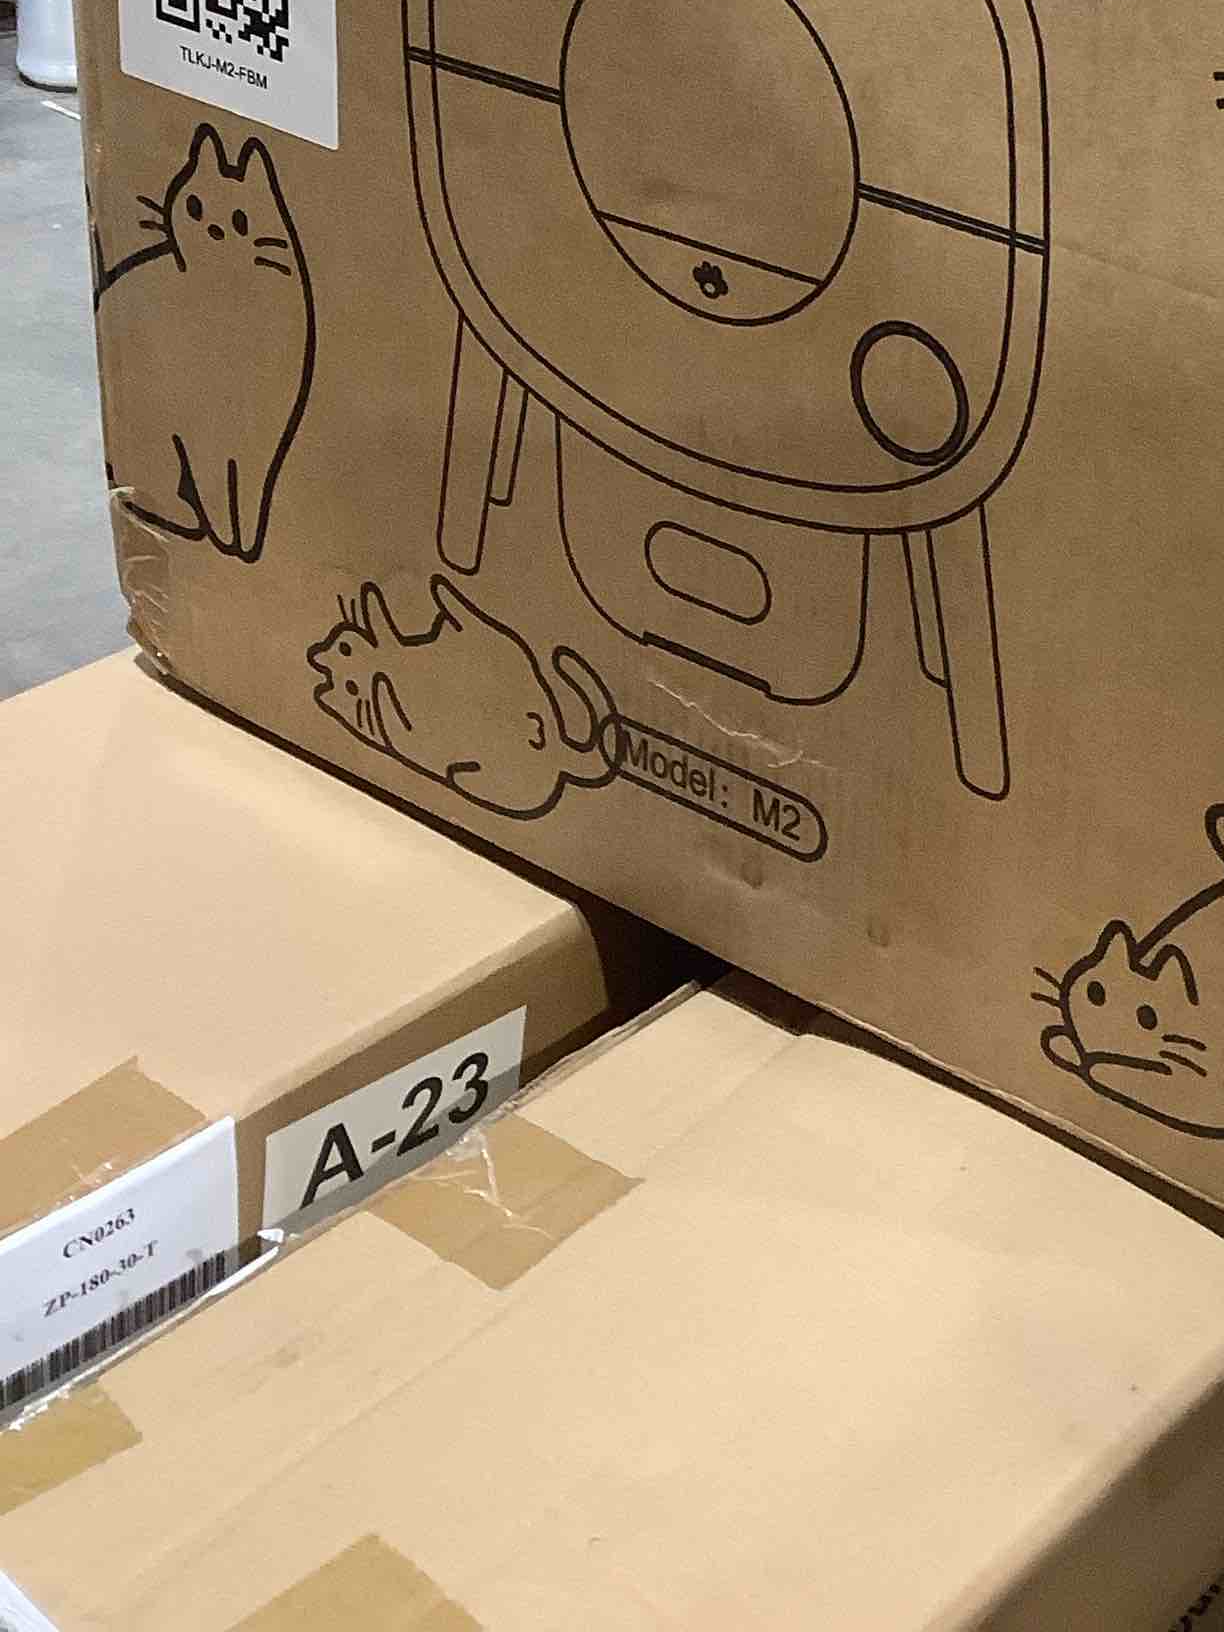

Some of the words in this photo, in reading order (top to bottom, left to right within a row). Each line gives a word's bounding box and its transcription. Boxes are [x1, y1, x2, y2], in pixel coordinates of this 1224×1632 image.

[180, 45, 268, 90] TLKJ-M2-FBM
[620, 728, 729, 809] Model:
[753, 787, 801, 841] M2
[300, 1051, 490, 1210] A-23
[62, 1208, 136, 1259] CN0263
[42, 1239, 159, 1318] ZP-180-30-T
